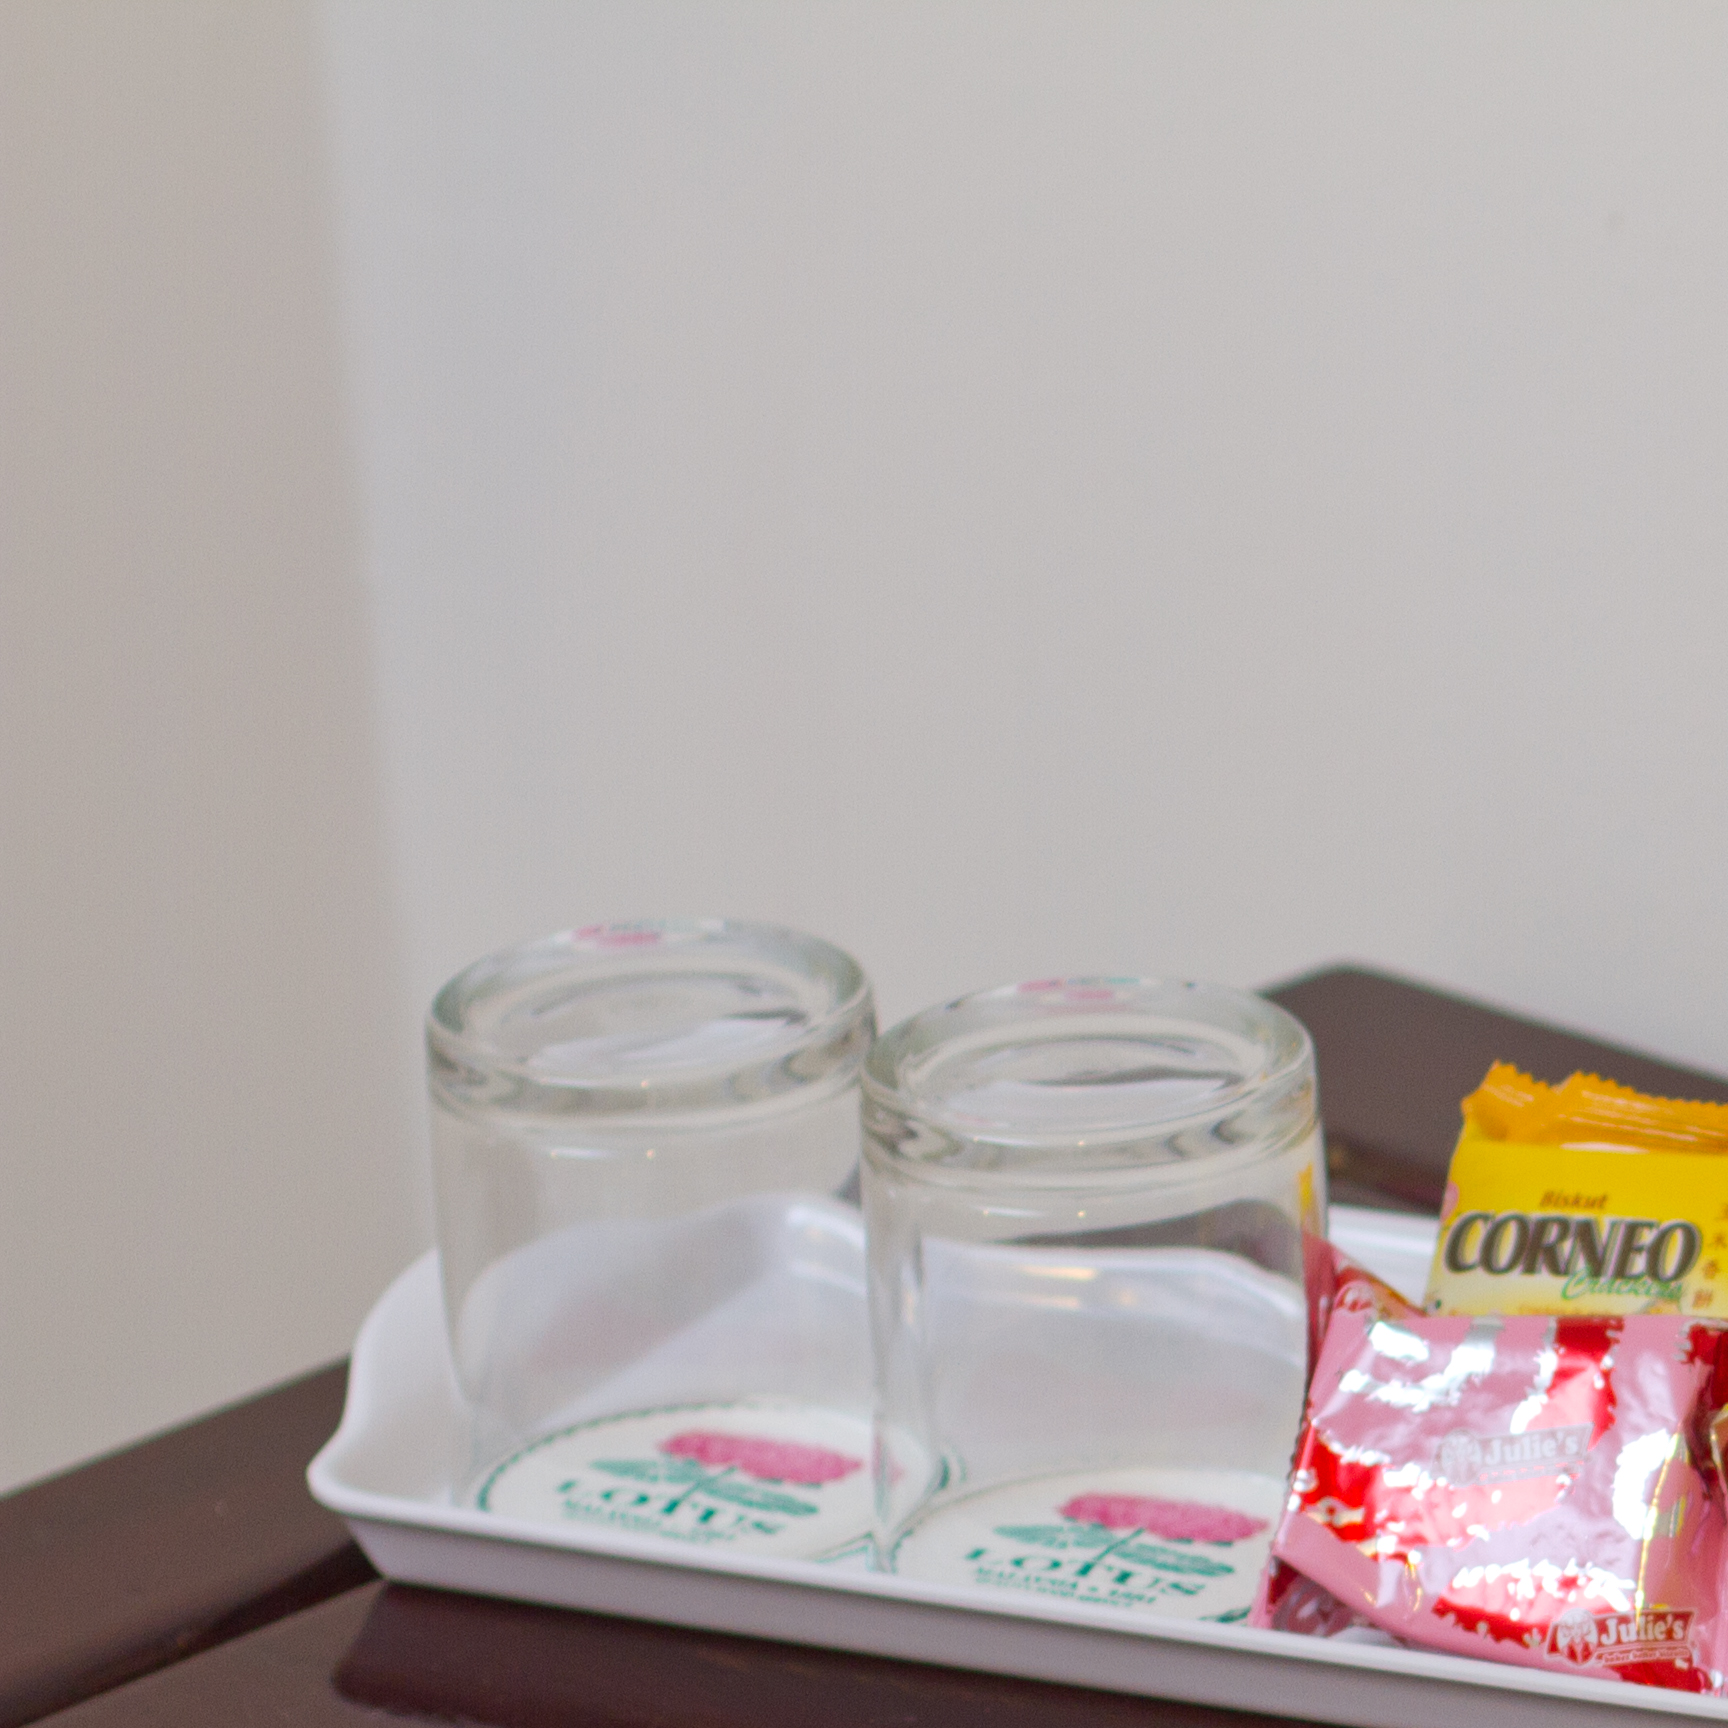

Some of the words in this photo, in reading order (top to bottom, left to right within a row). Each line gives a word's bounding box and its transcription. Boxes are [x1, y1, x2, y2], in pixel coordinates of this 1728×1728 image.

[1540, 1188, 1608, 1211] Biskut
[1444, 1211, 1702, 1283] CORNEO
[1484, 1428, 1578, 1467] Julie's
[964, 1548, 1206, 1597] LOTUS
[1600, 1612, 1684, 1646] Julie's
